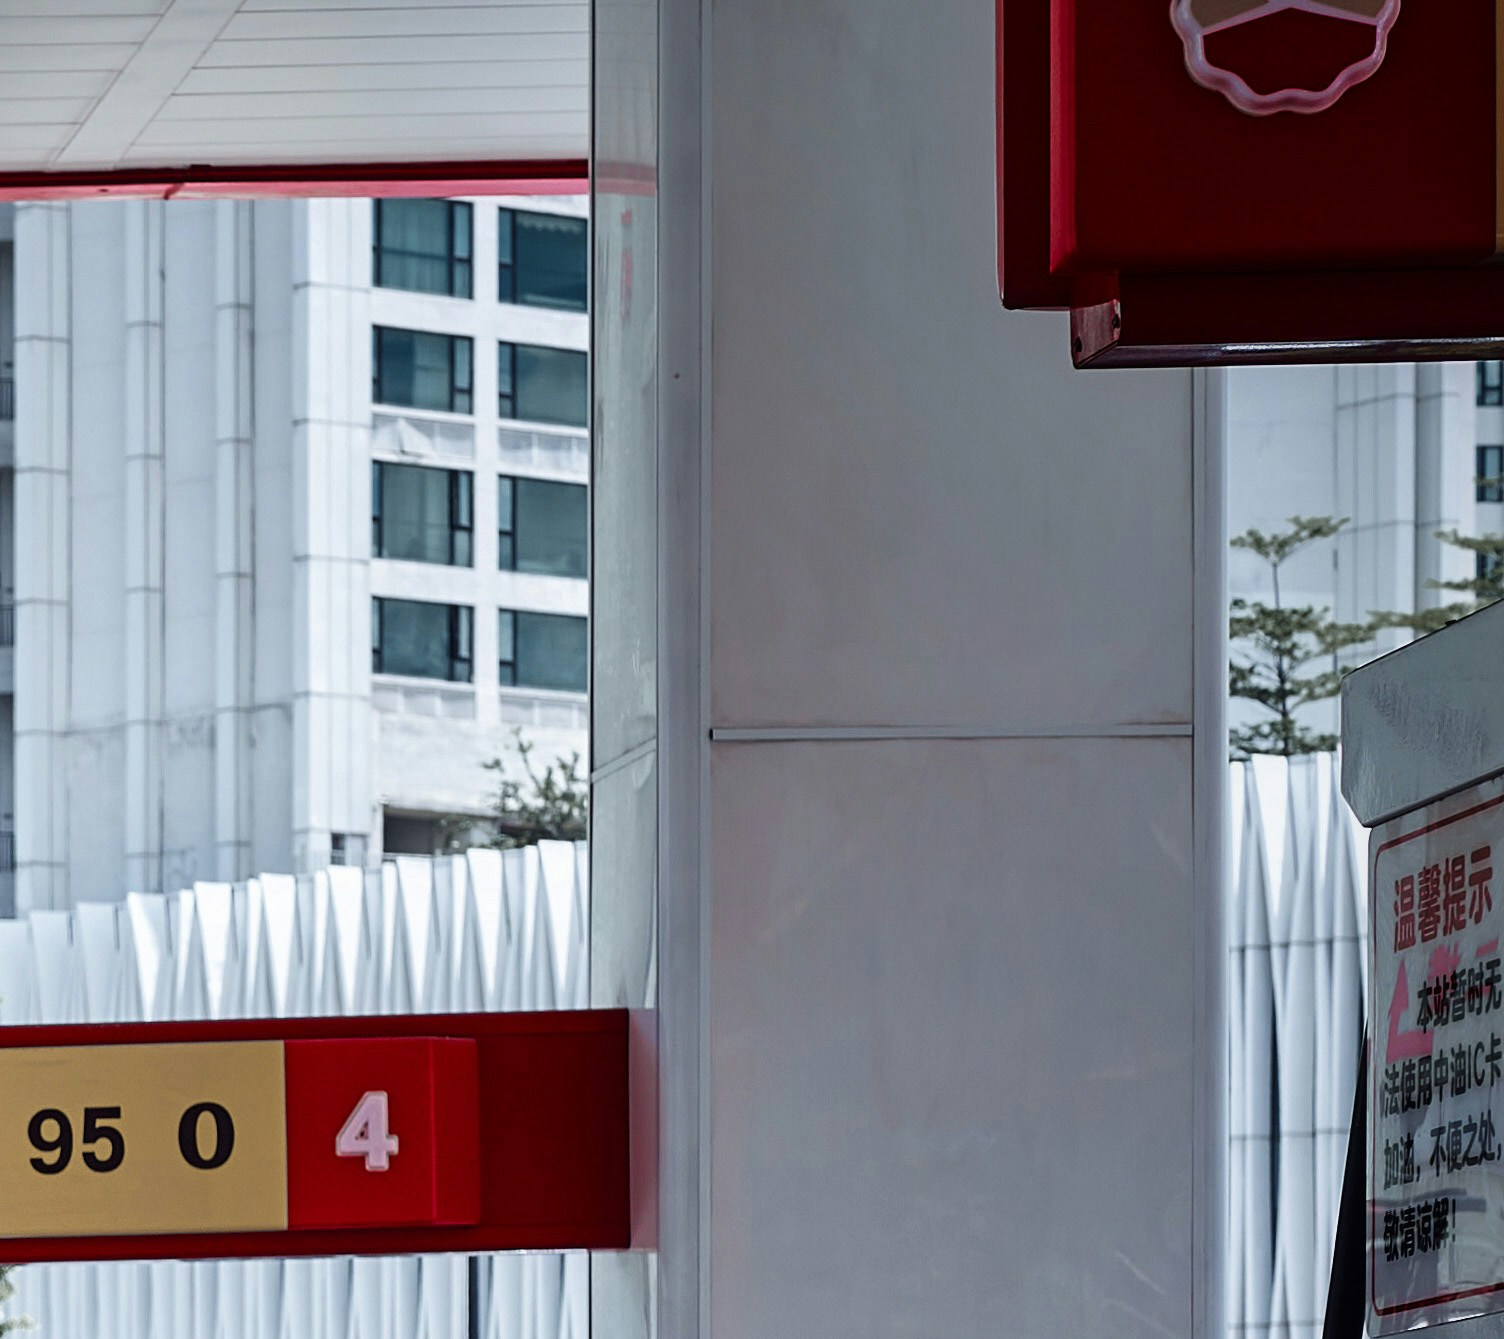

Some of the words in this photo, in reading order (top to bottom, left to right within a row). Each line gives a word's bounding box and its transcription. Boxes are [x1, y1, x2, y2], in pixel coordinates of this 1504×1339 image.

[1393, 845, 1493, 953] 温馨提示
[1416, 957, 1502, 1034] 本站暂时无
[27, 1106, 125, 1175] 95
[178, 1101, 235, 1170] 0
[335, 1090, 400, 1172] 4
